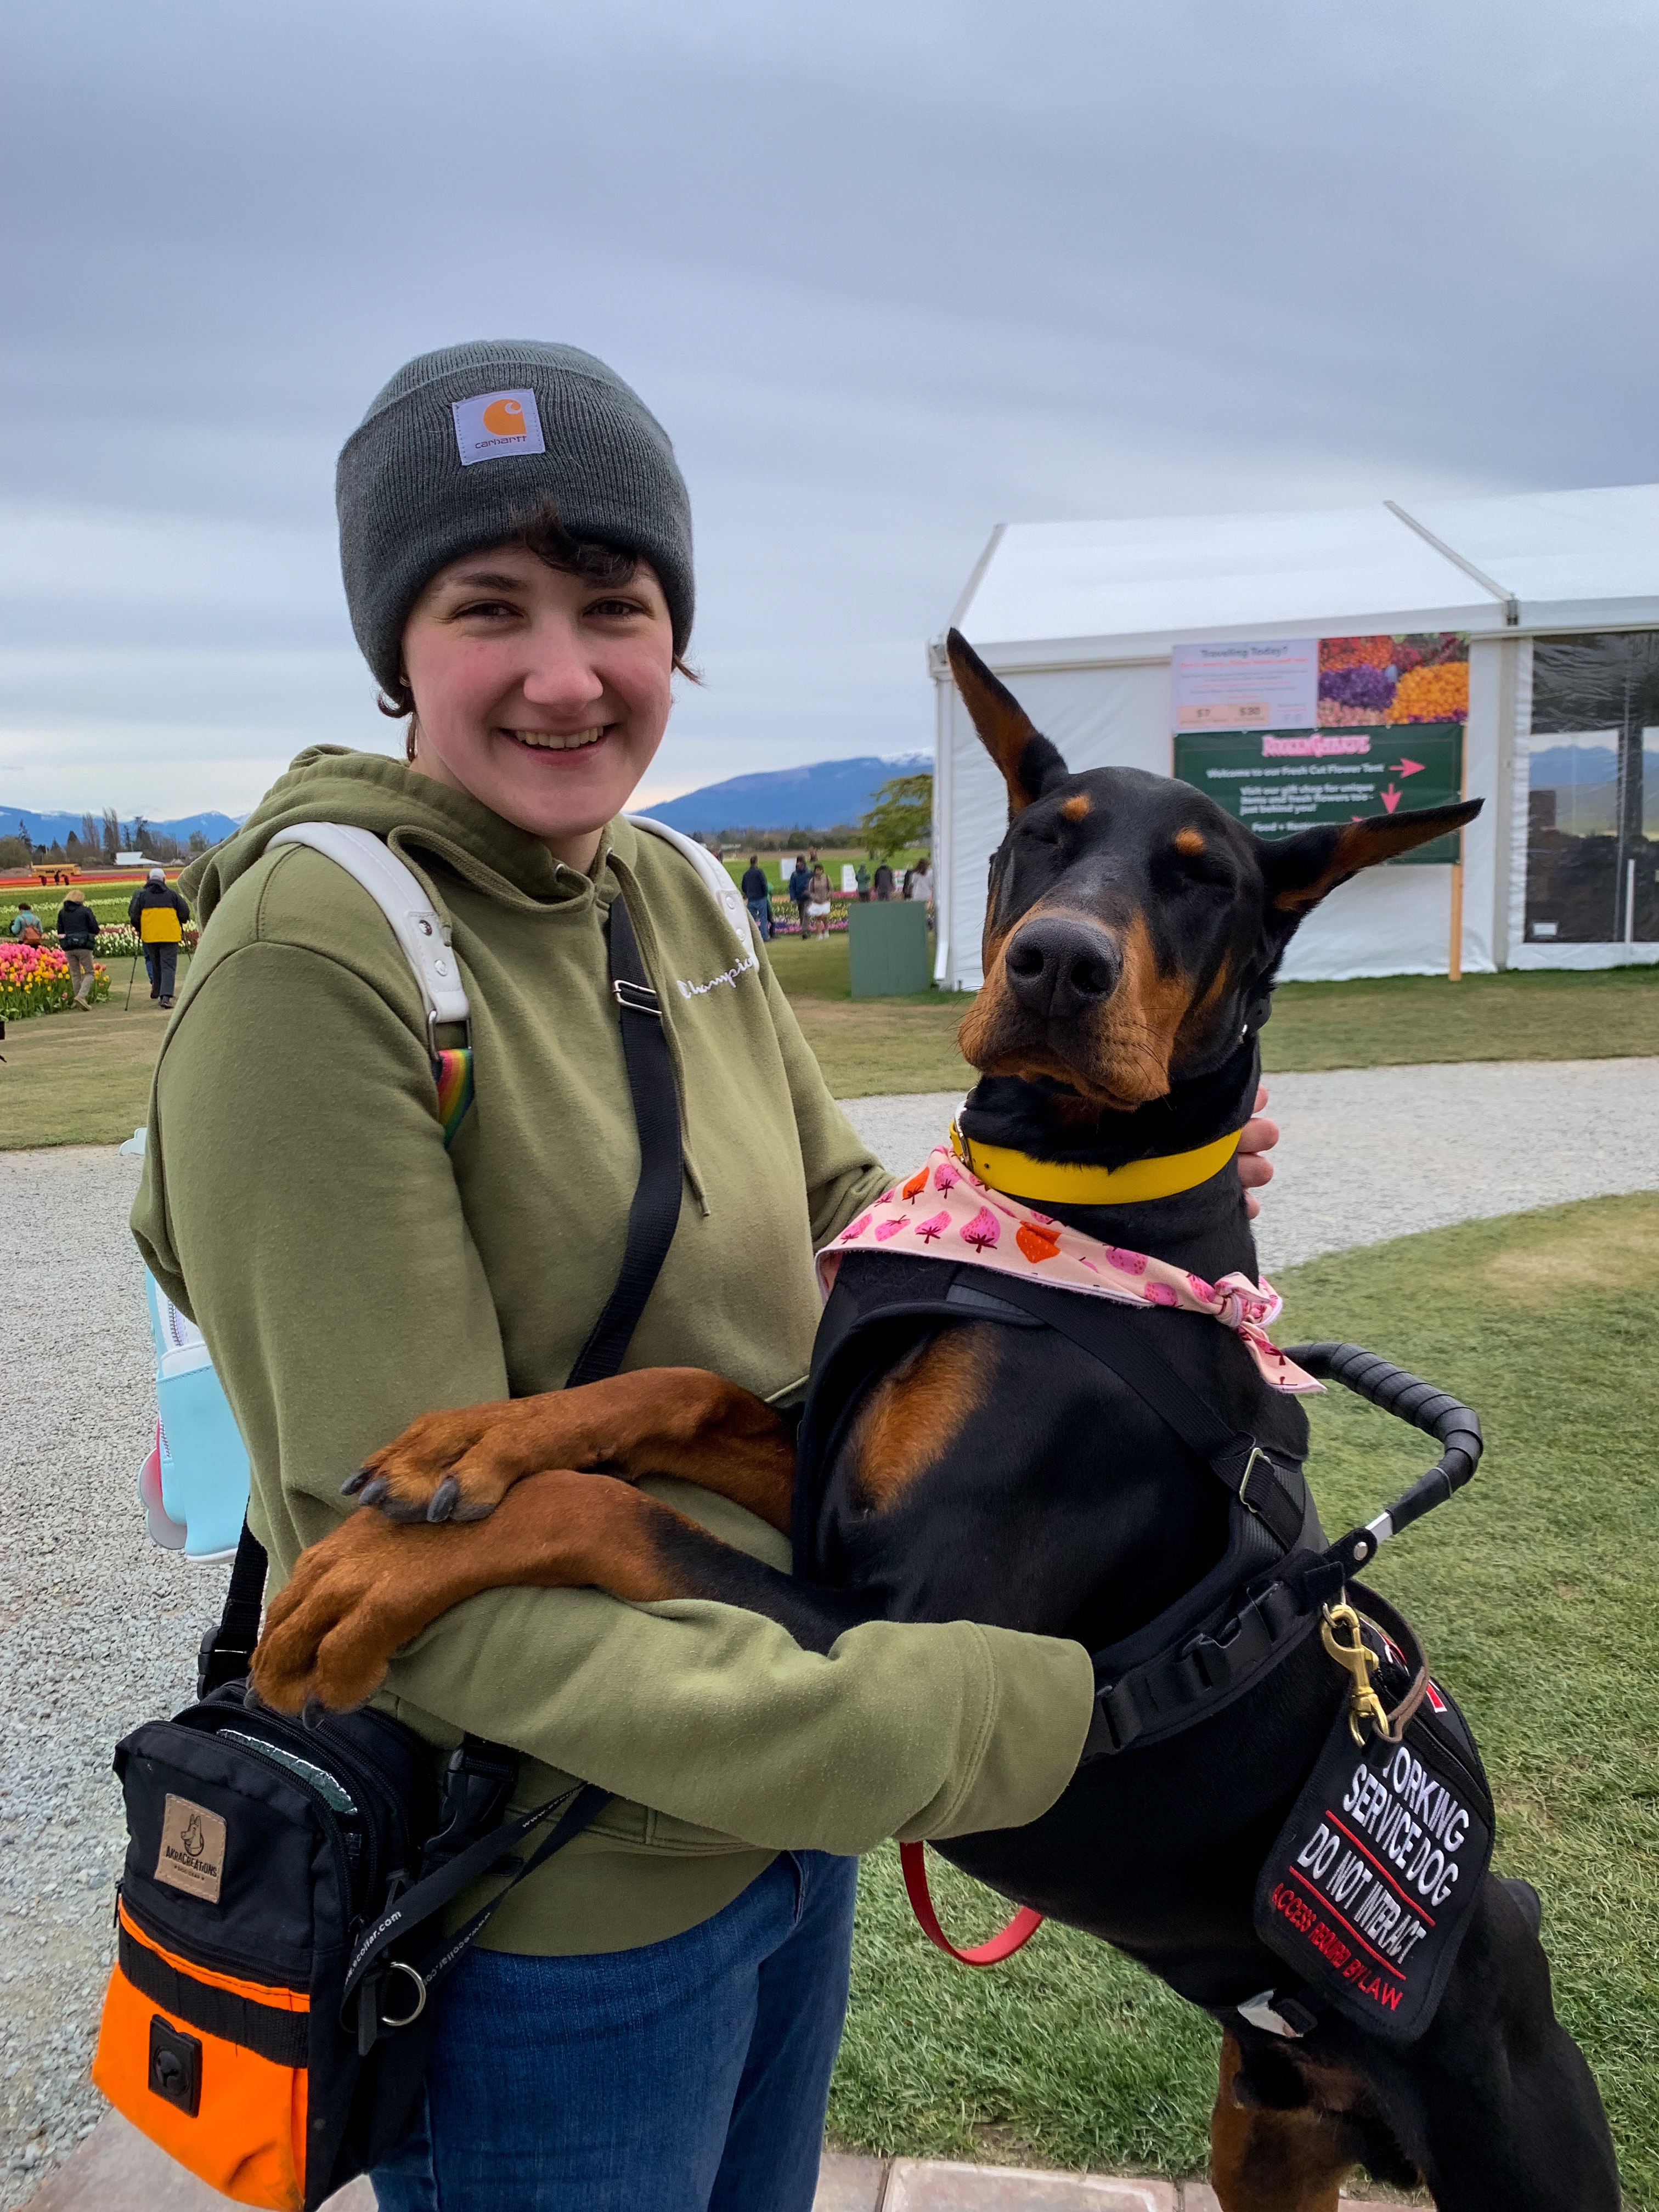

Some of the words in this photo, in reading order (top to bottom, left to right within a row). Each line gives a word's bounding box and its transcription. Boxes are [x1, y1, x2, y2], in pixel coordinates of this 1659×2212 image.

[475, 436, 527, 449] carhartt
[677, 957, 754, 999] Champio
[1343, 1763, 1423, 1870] SERVICE
[1406, 1837, 1459, 1906] DOG
[1271, 1882, 1317, 1932] ACCESS
[1297, 1823, 1340, 1880] DO
[1325, 1850, 1373, 1910] NOT
[1354, 1881, 1426, 1965] INTERACT
